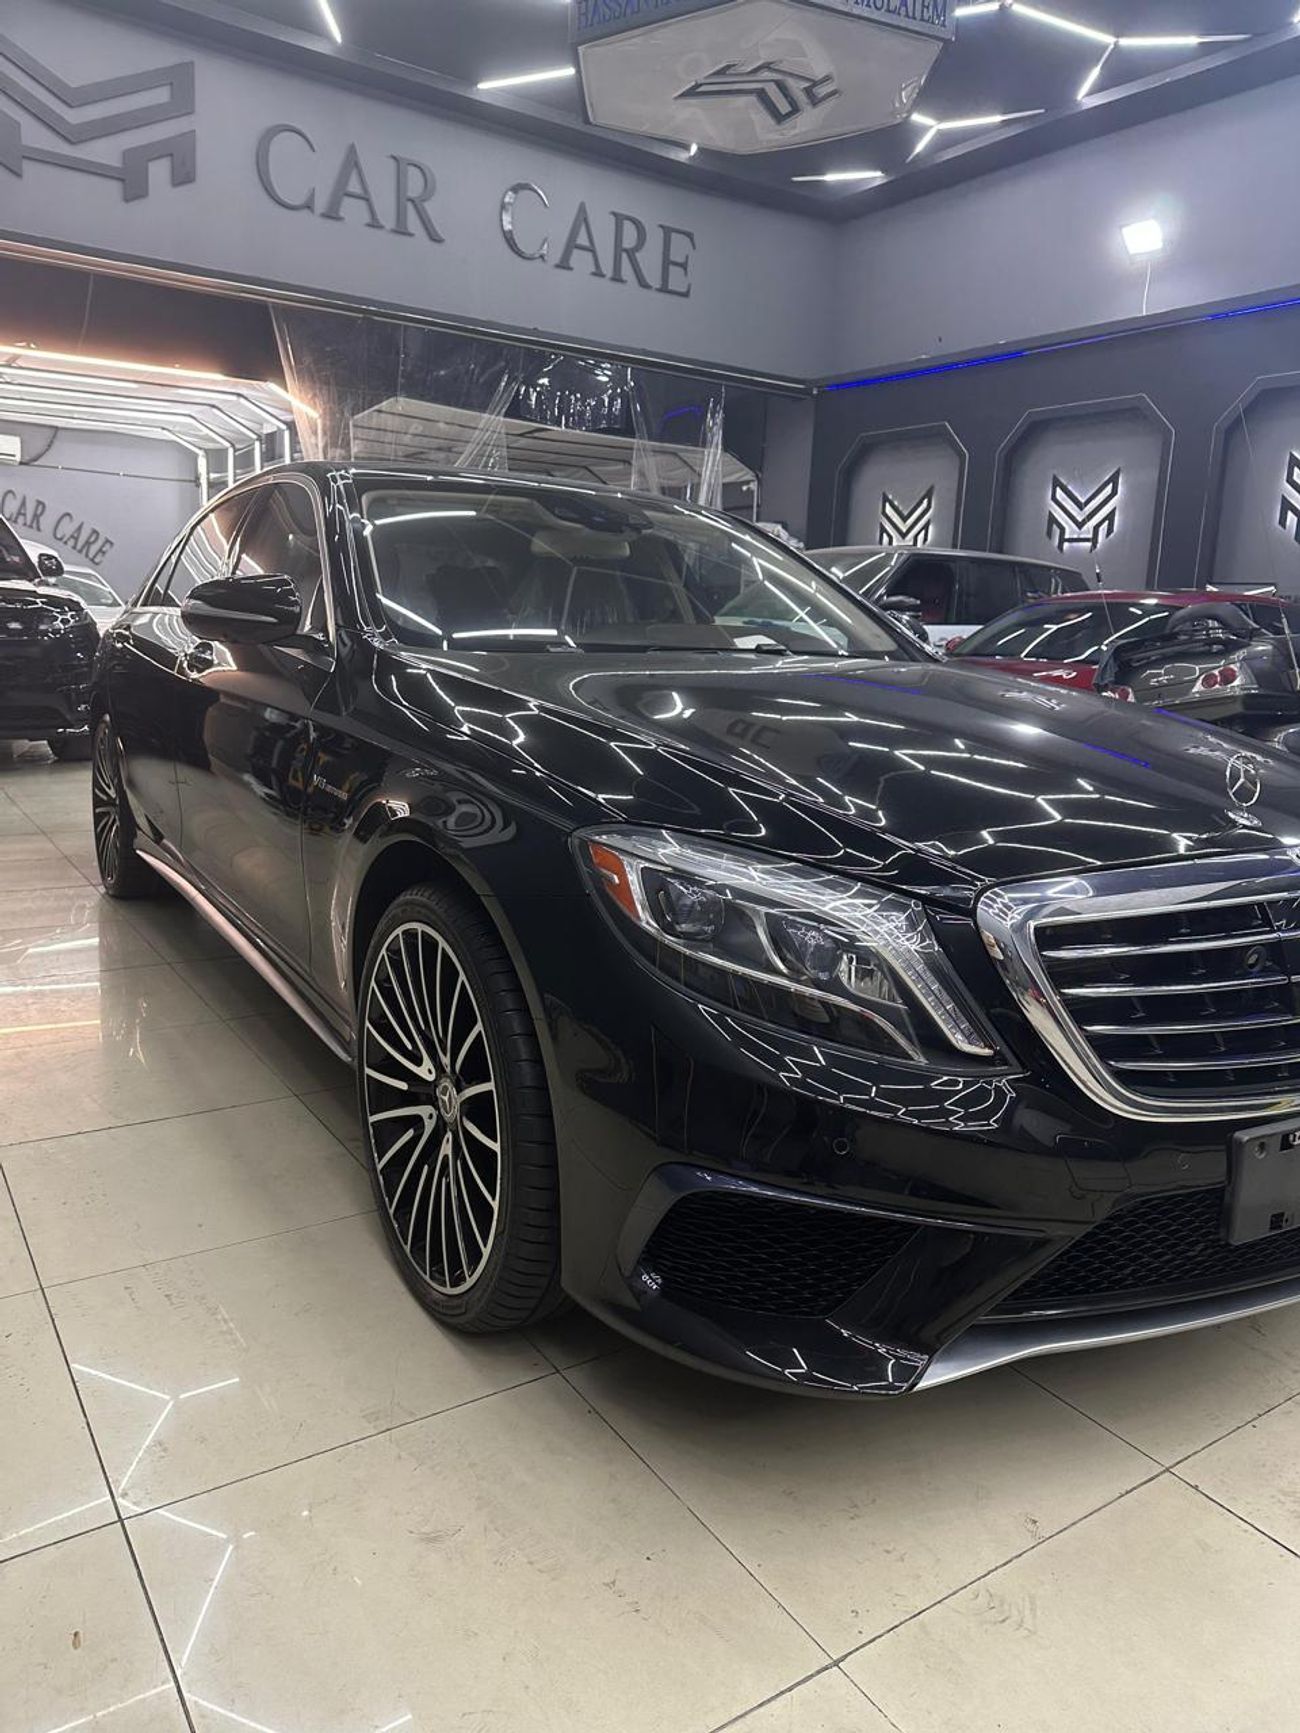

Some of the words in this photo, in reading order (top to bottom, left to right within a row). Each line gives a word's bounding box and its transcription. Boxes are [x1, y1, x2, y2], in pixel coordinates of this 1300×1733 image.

[576, 0, 655, 30] HASSA
[255, 124, 446, 244] CAR
[500, 182, 697, 298] CARE
[1, 489, 46, 533] CAR
[52, 512, 115, 566] CARE
